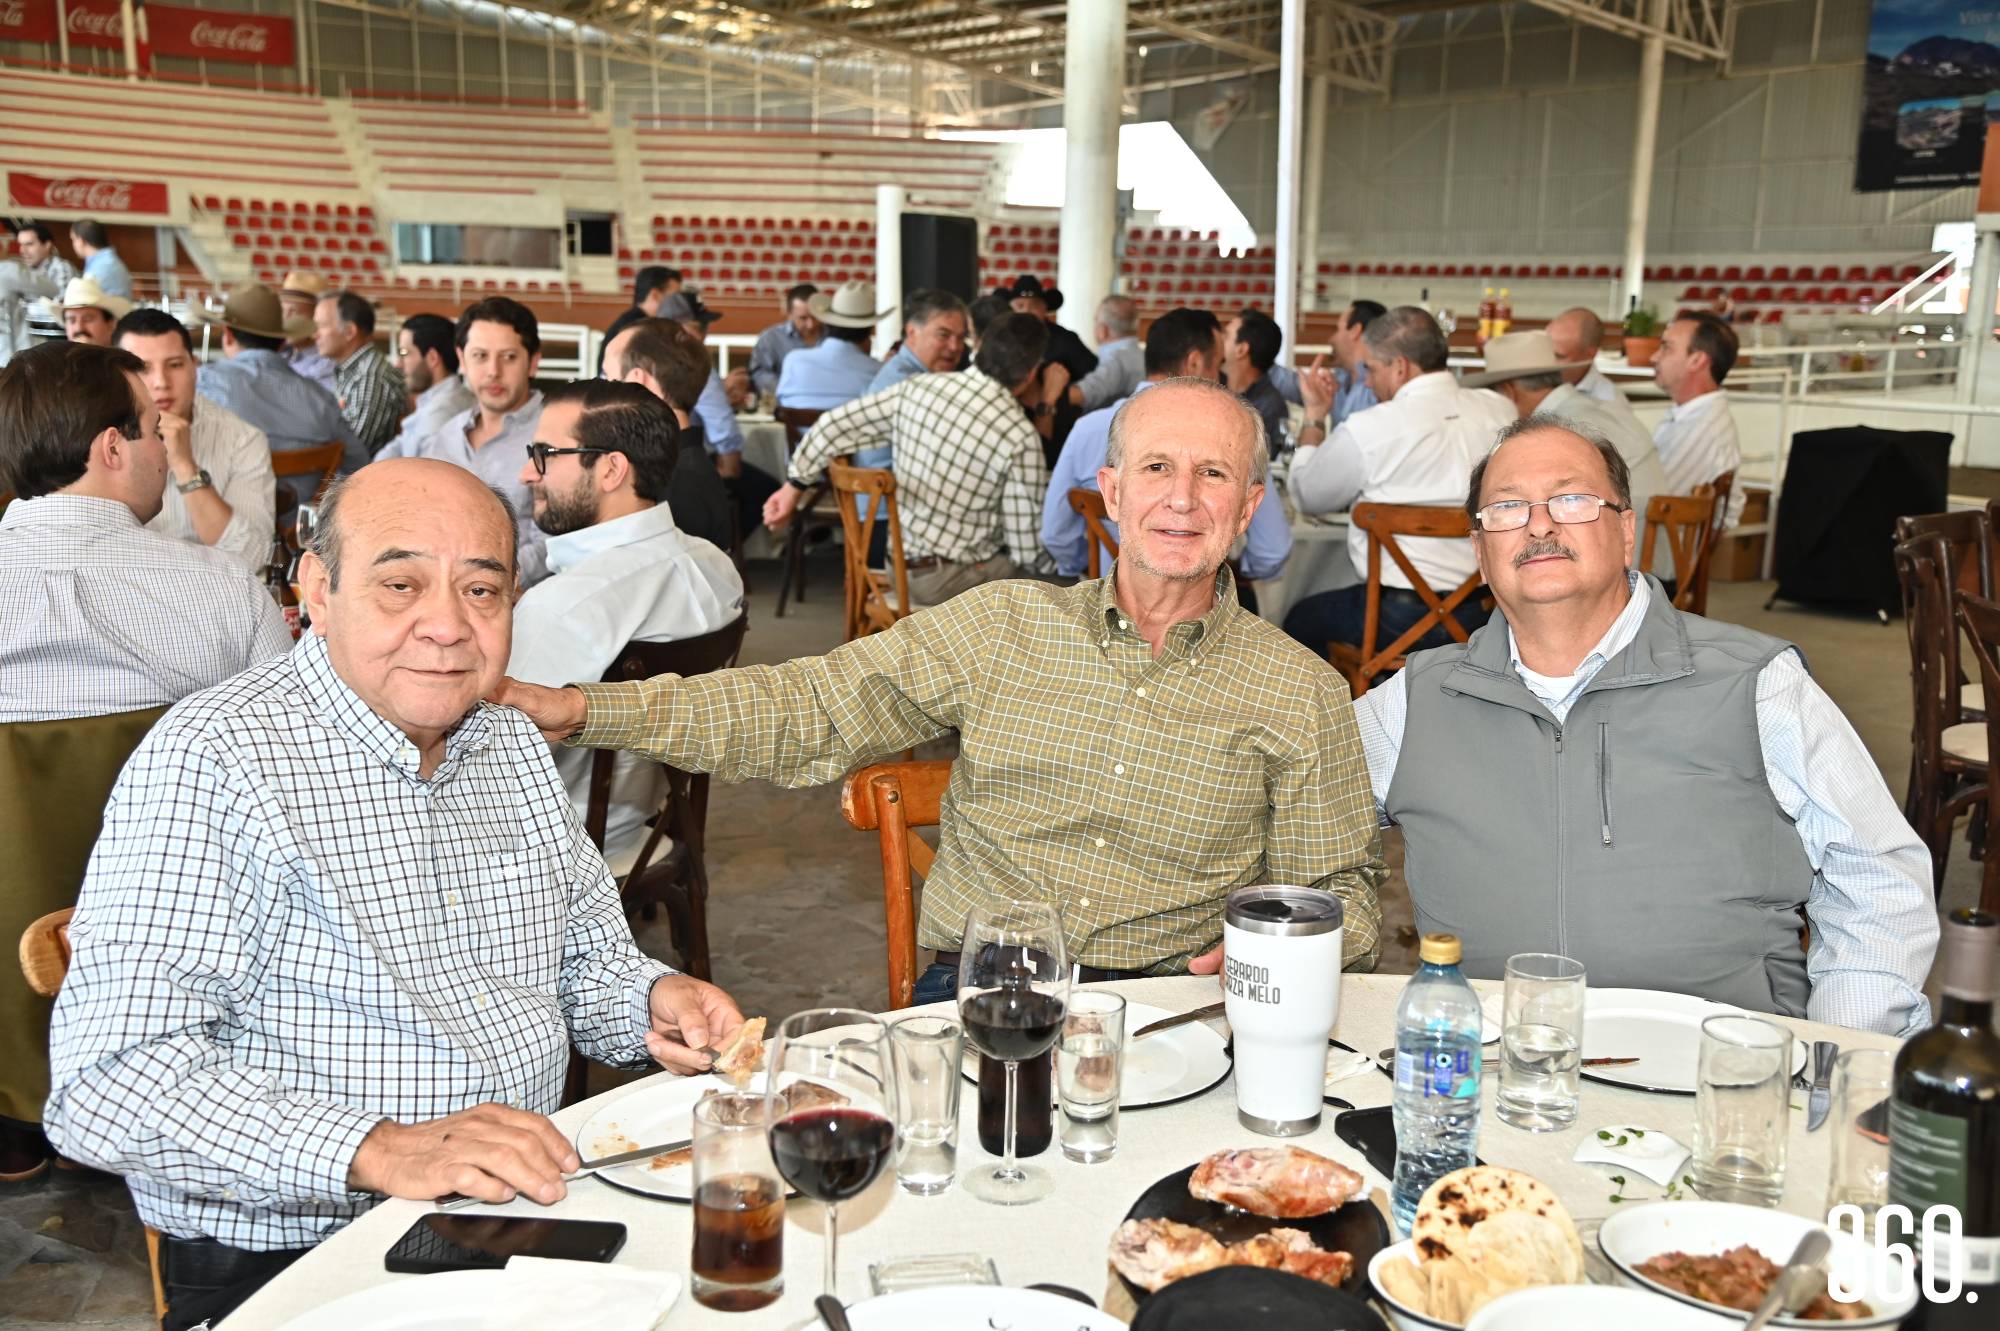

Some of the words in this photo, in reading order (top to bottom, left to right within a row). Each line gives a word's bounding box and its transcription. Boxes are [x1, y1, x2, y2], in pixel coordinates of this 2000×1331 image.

[190, 20, 267, 52] Coca-Cola
[44, 179, 131, 209] Coca-Cola
[1248, 983, 1281, 1005] MELO
